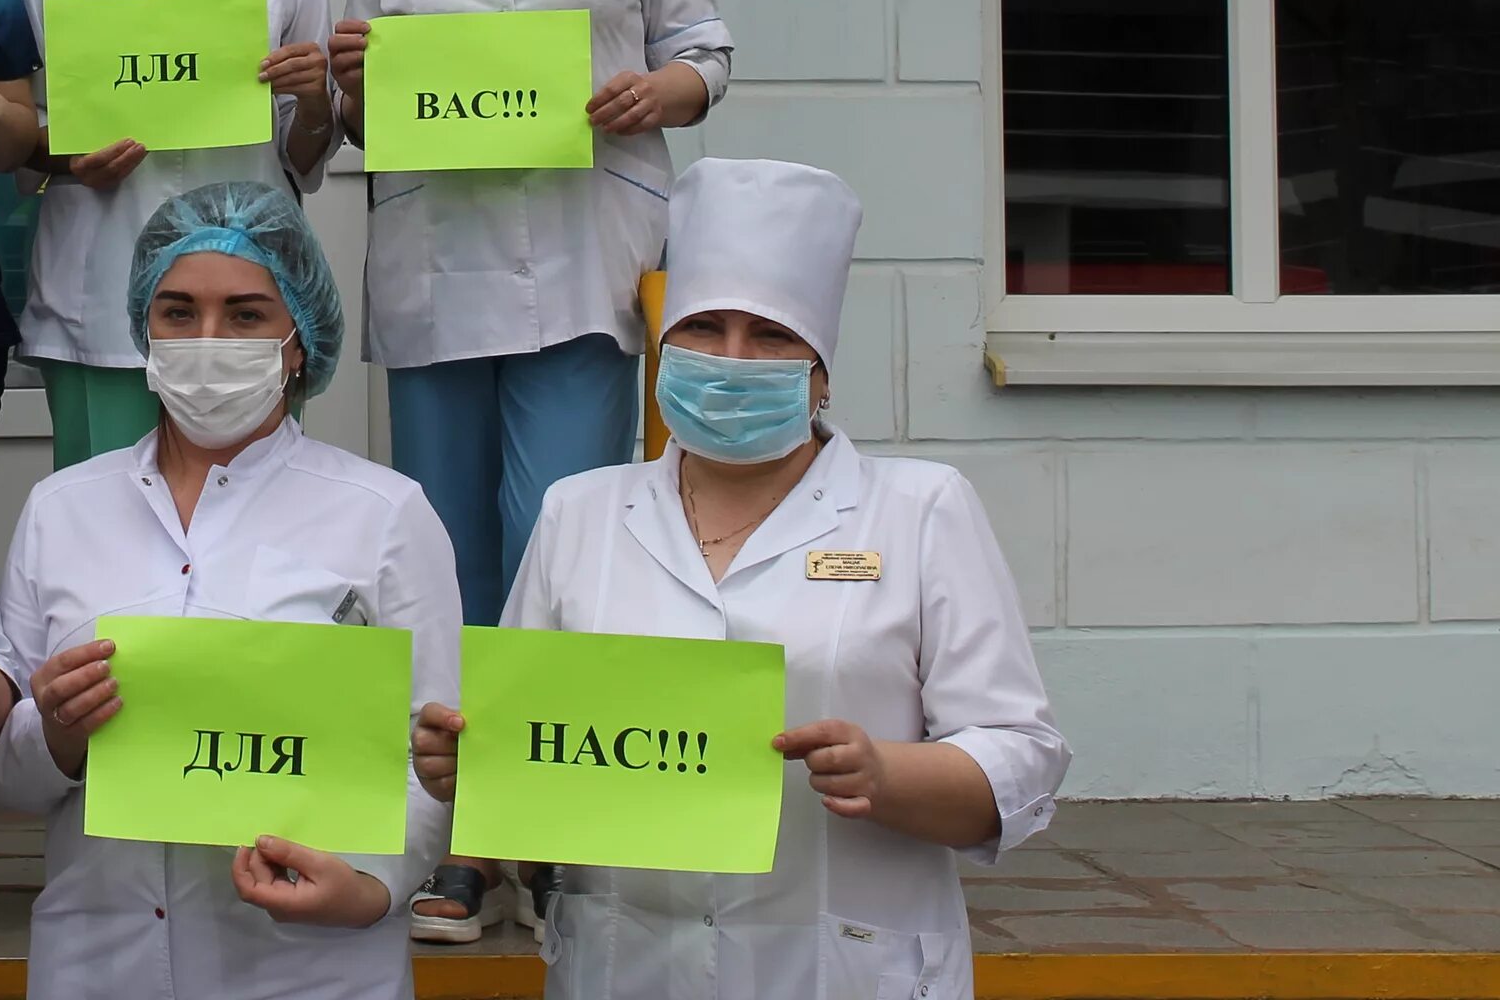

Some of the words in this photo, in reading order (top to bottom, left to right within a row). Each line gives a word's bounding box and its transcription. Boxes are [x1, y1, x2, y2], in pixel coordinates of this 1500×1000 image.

[114, 52, 199, 88] ДЛЯ
[415, 89, 538, 120] ВАС!!!
[183, 729, 308, 781] ДЛЯ
[526, 721, 708, 774] НАС!!!
